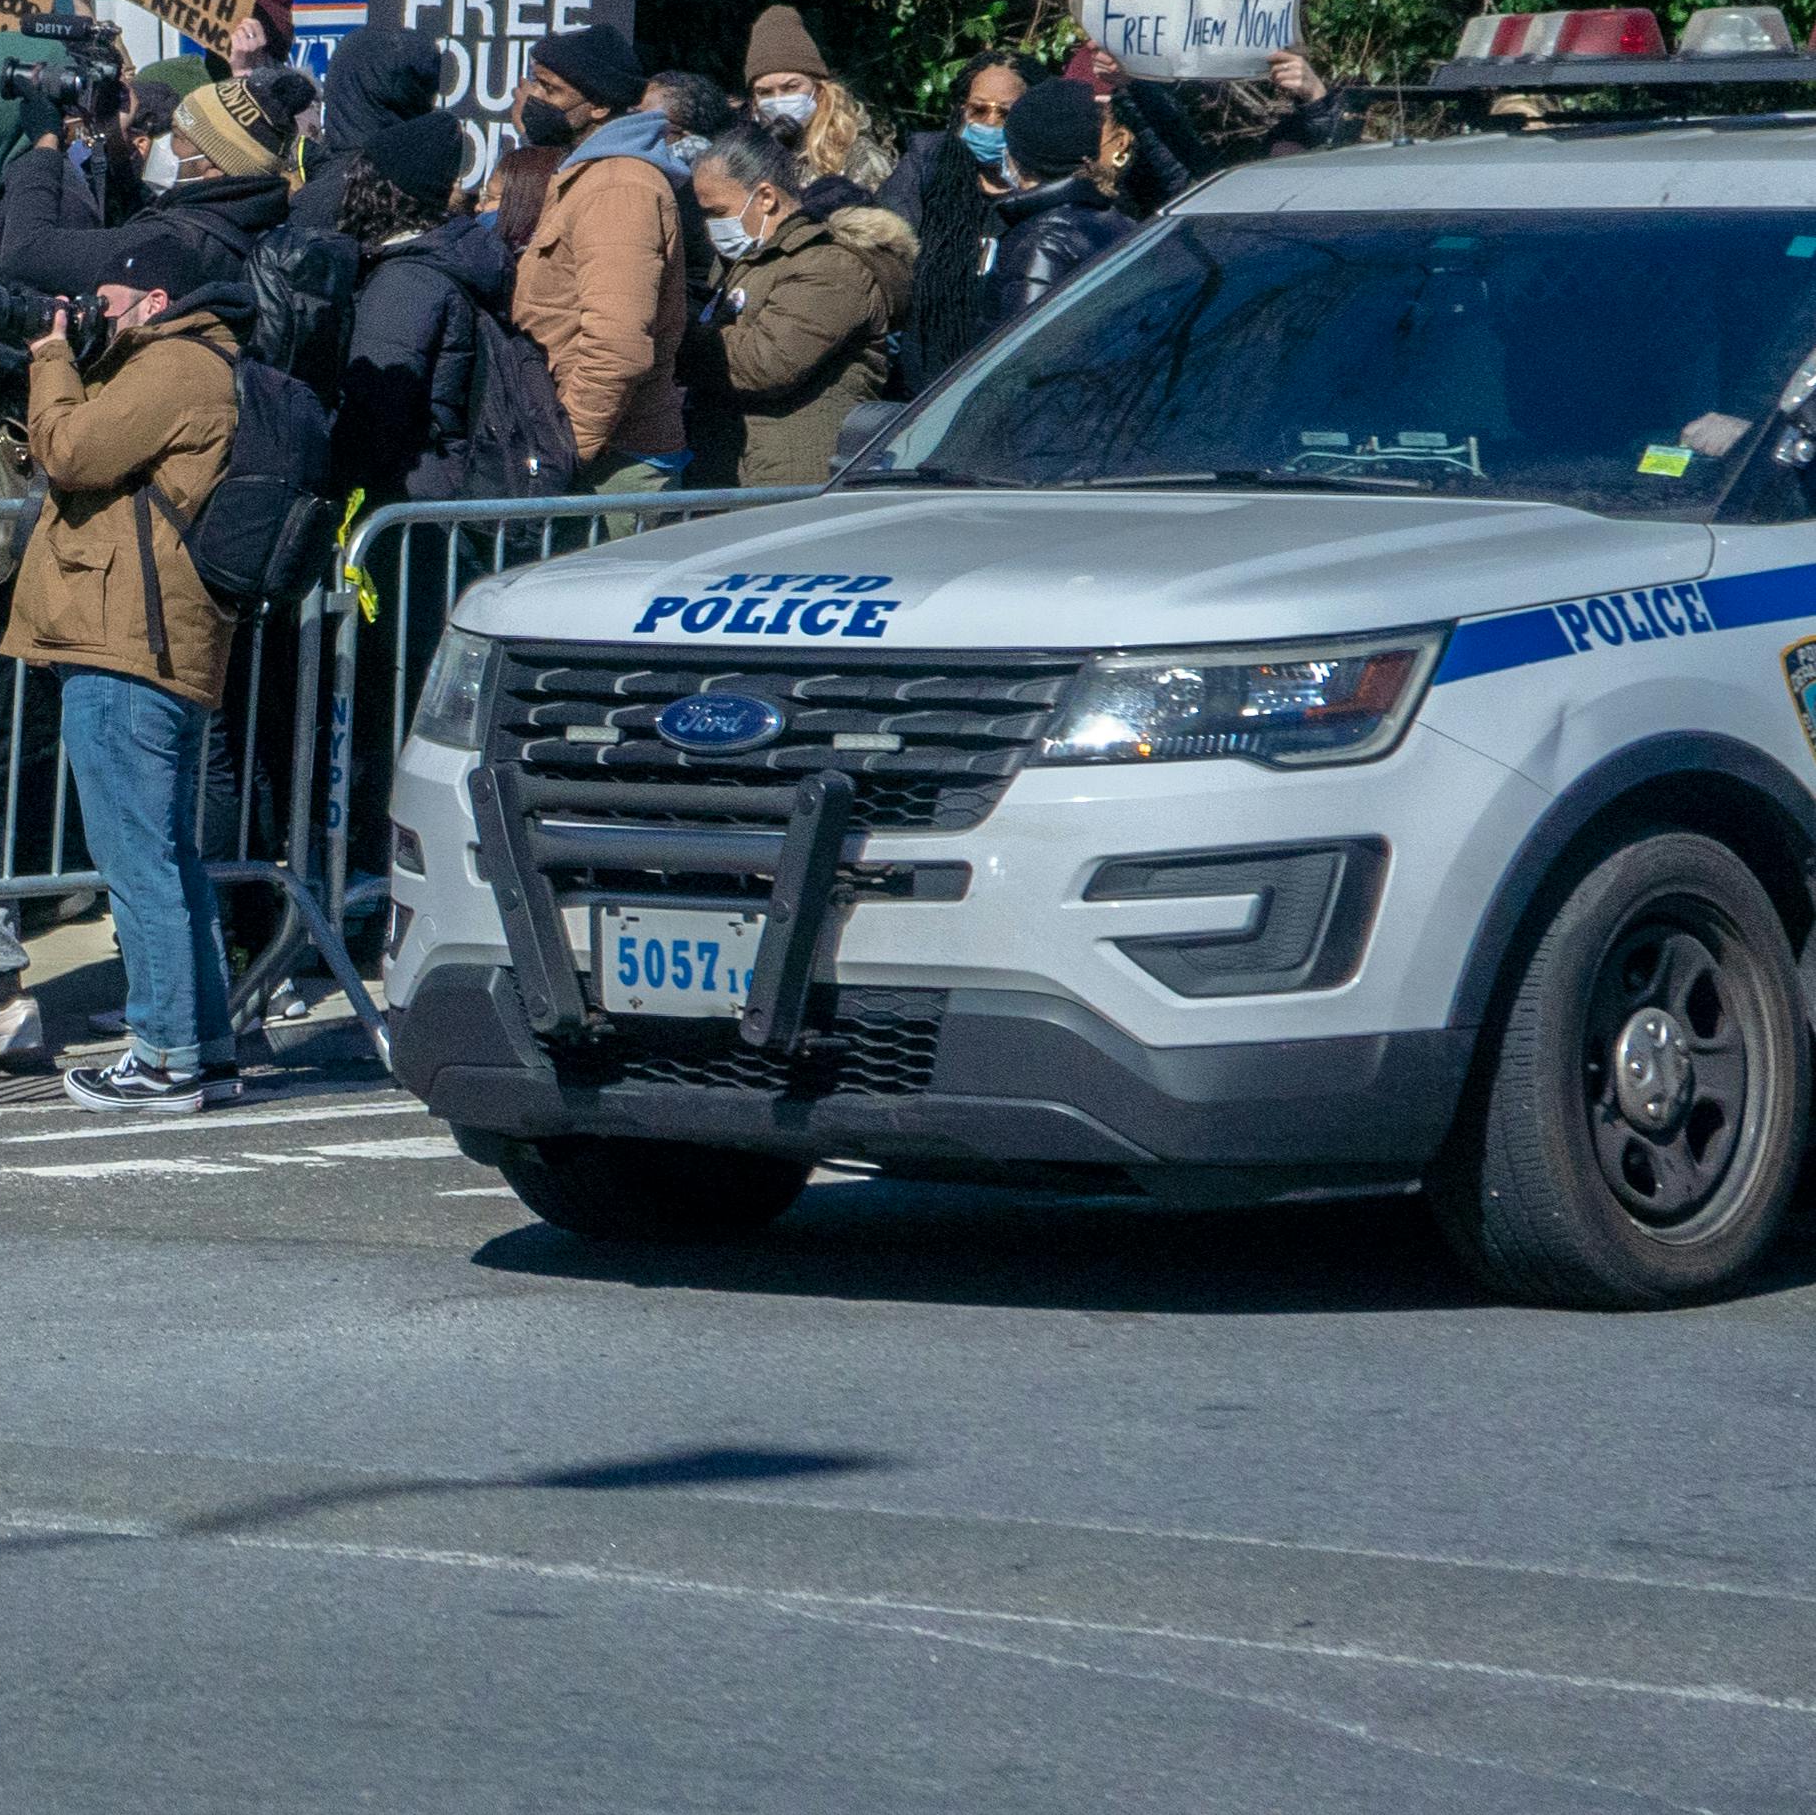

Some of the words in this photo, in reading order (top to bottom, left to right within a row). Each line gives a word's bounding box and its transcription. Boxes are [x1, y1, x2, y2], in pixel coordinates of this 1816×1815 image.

[36, 23, 72, 34] DEITY
[436, 38, 538, 112] OU
[704, 574, 894, 593] NYPD
[633, 597, 900, 639] POLICE
[1560, 582, 1710, 654] POLICE
[675, 703, 747, 734] Ford
[326, 698, 347, 829] NYPD
[619, 937, 719, 991] 5057
